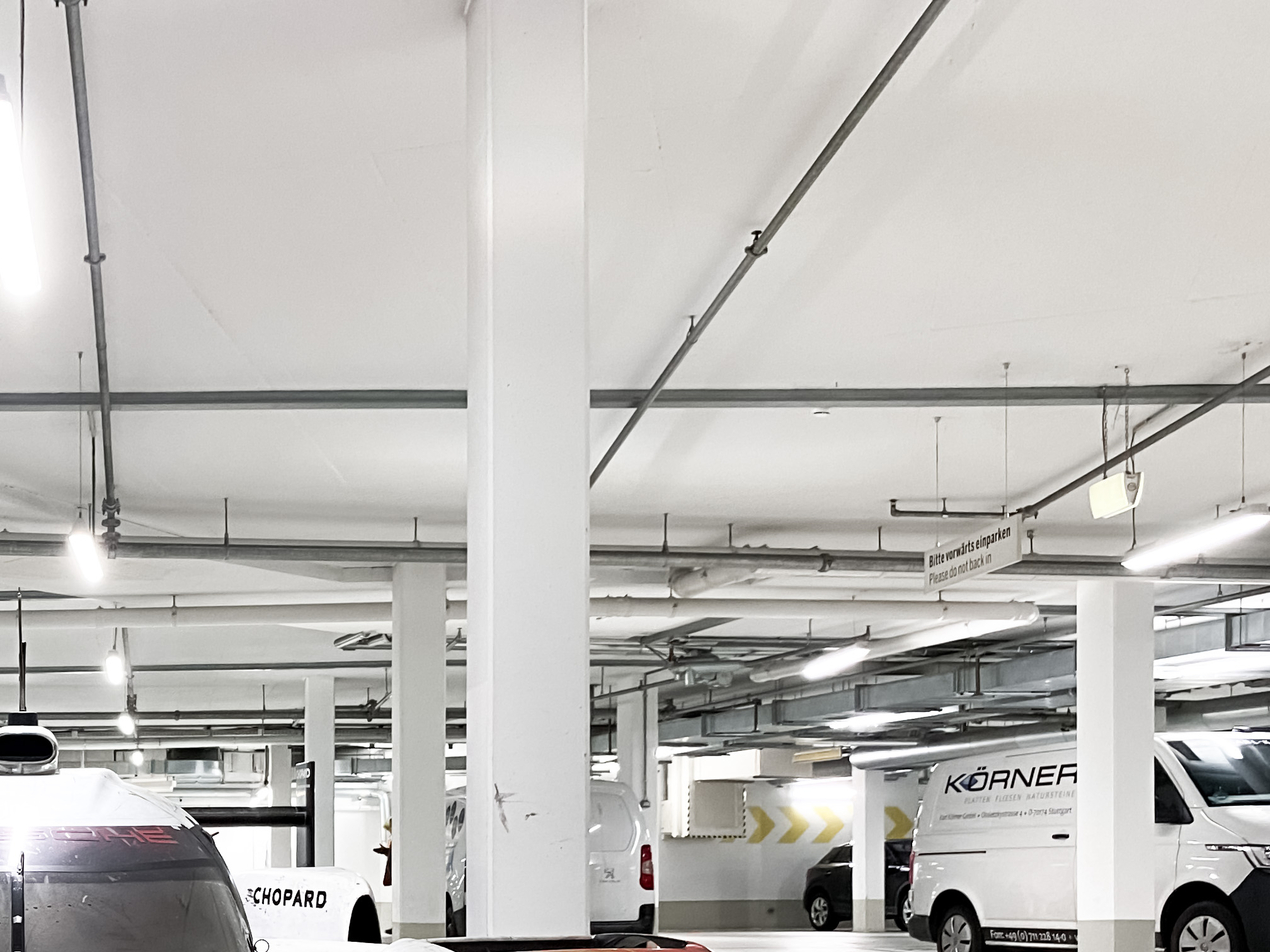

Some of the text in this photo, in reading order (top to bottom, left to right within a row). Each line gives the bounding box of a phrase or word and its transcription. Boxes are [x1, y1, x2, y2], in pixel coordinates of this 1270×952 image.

[929, 526, 1011, 568] Bitte vorwärts einparken
[929, 553, 992, 585] Please do not back in
[944, 763, 1077, 794] KÖRNER
[1026, 790, 1076, 800] NATURSTEINE
[253, 886, 327, 909] CHOPARD
[1017, 929, 1029, 942] (0)
